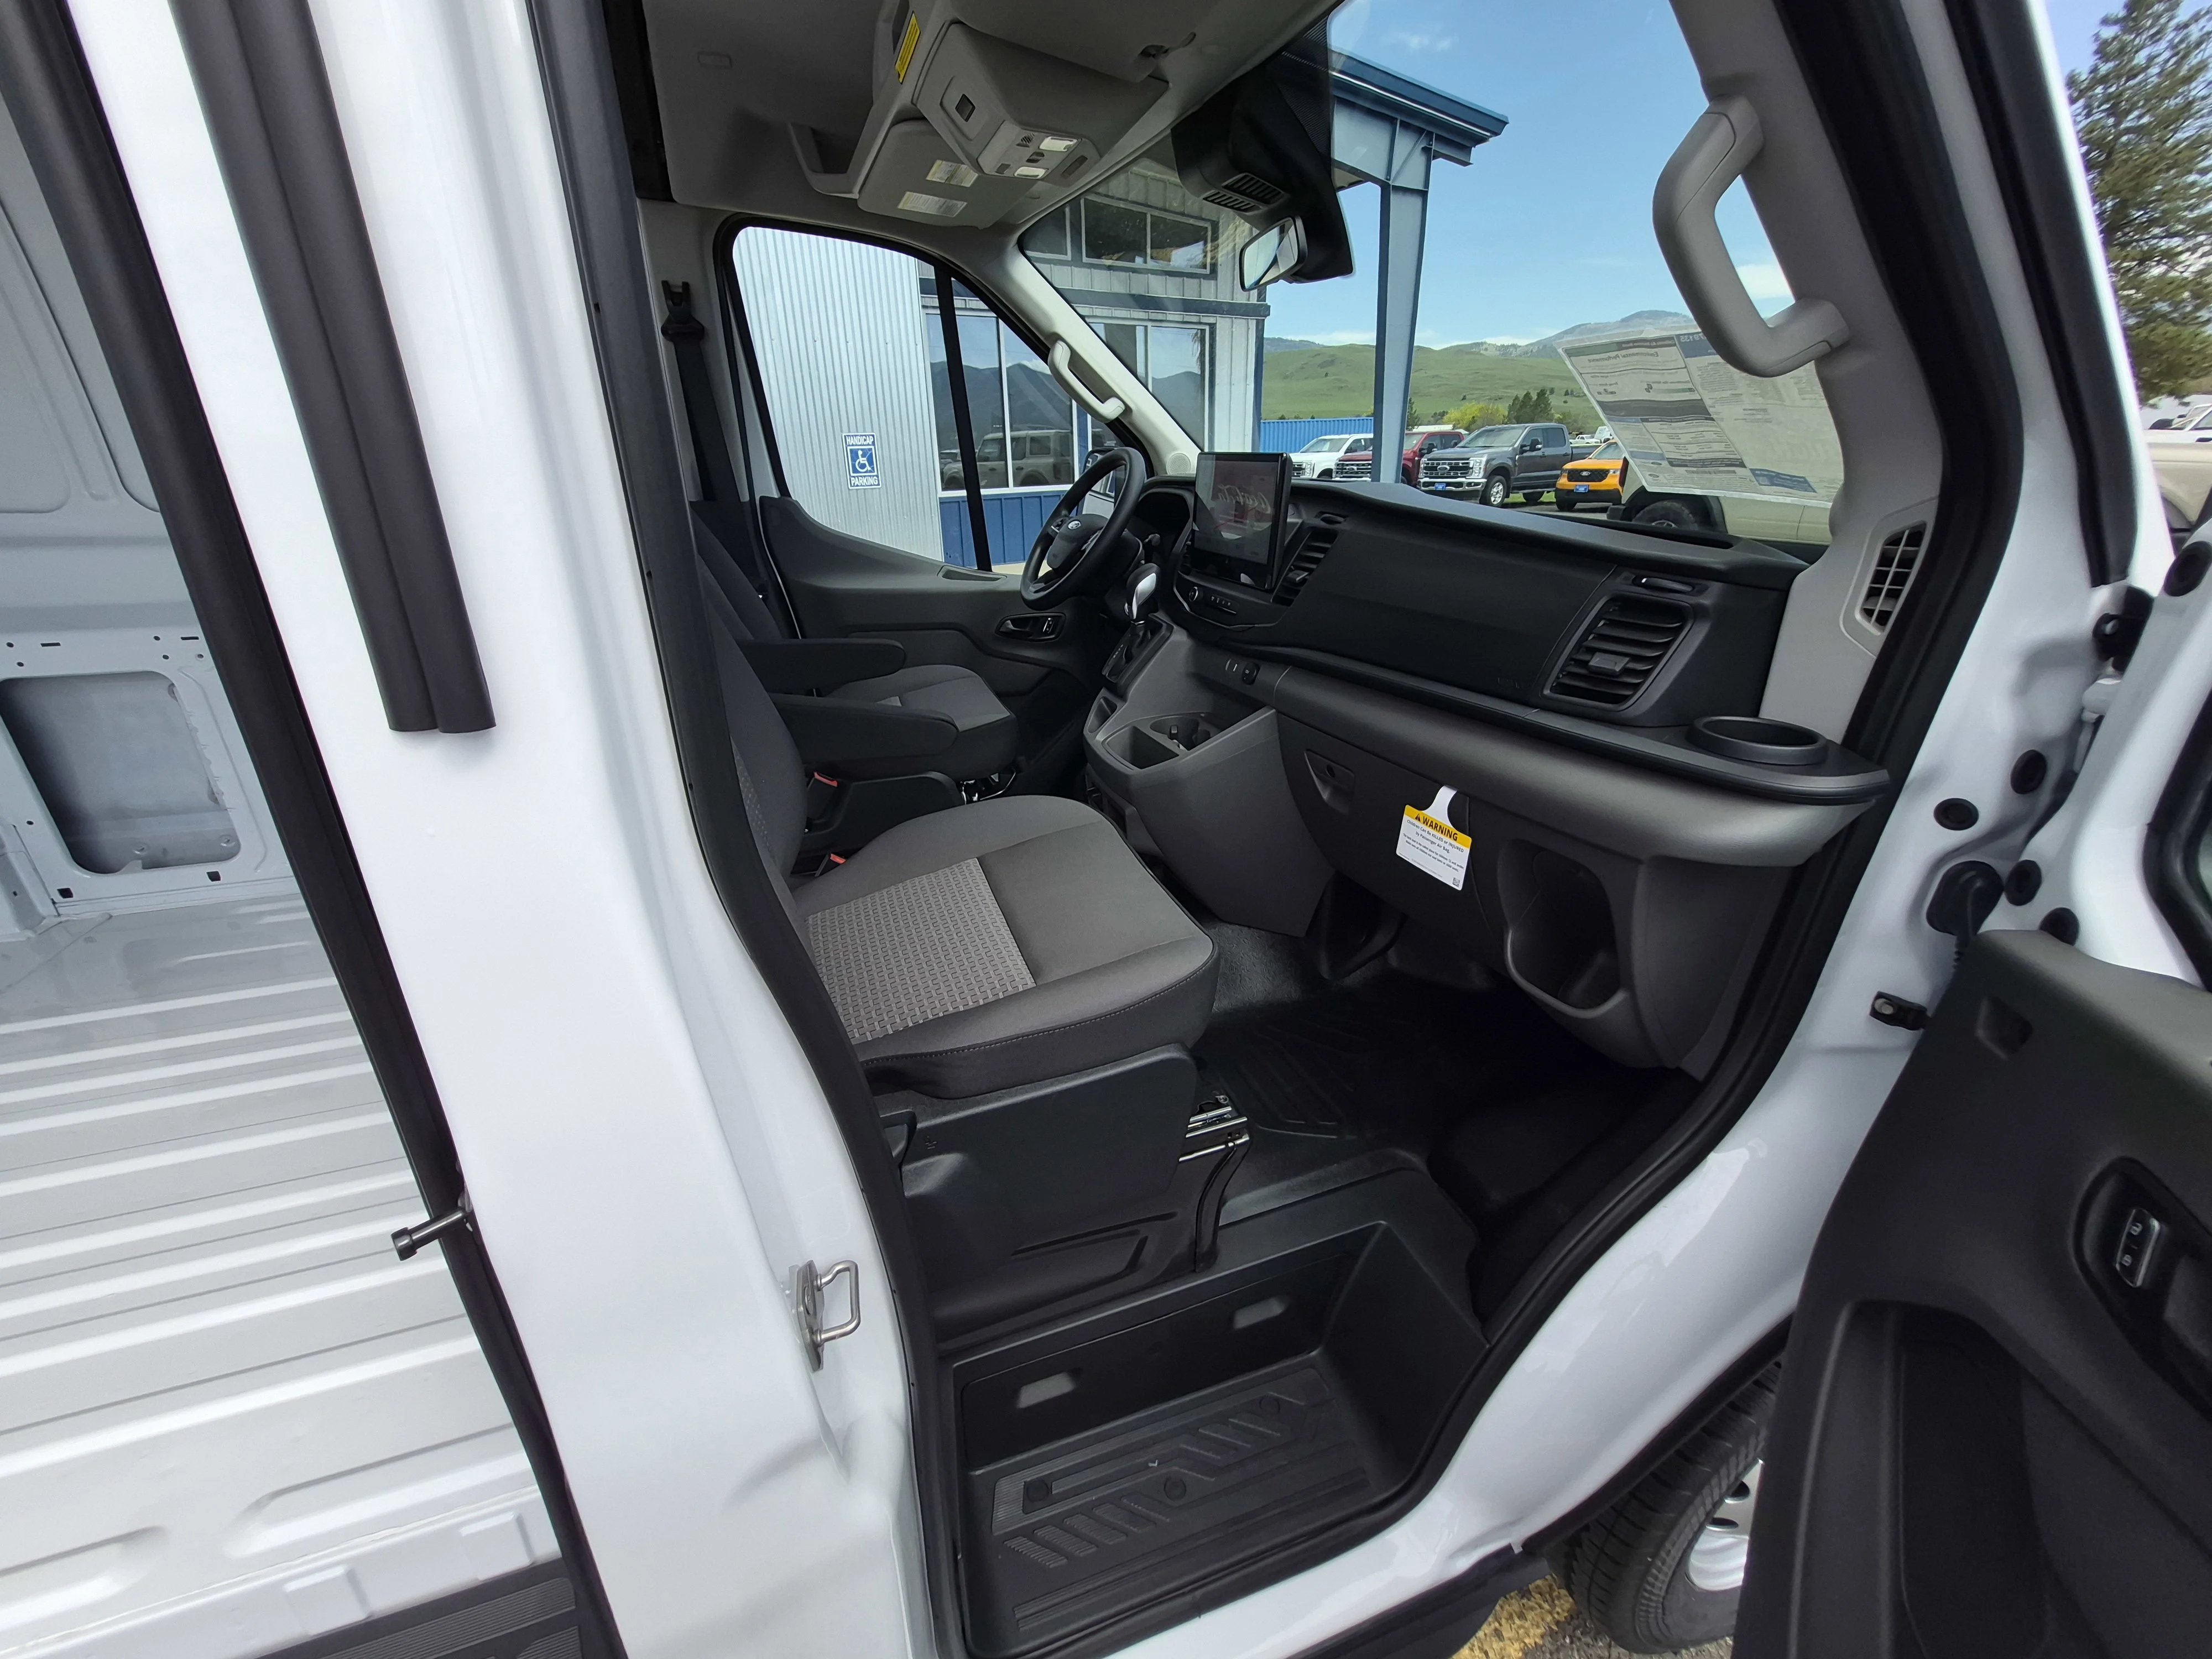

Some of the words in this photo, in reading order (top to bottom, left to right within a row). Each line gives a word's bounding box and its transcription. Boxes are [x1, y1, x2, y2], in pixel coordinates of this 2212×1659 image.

[846, 436, 873, 445] HANDICAP
[851, 476, 878, 486] PARKING
[1423, 816, 1458, 841] WARNING
[1407, 819, 1420, 829] Children
[1432, 833, 1443, 842] KILLED
[1448, 842, 1464, 852] INJURED
[1420, 834, 1436, 846] Passenger
